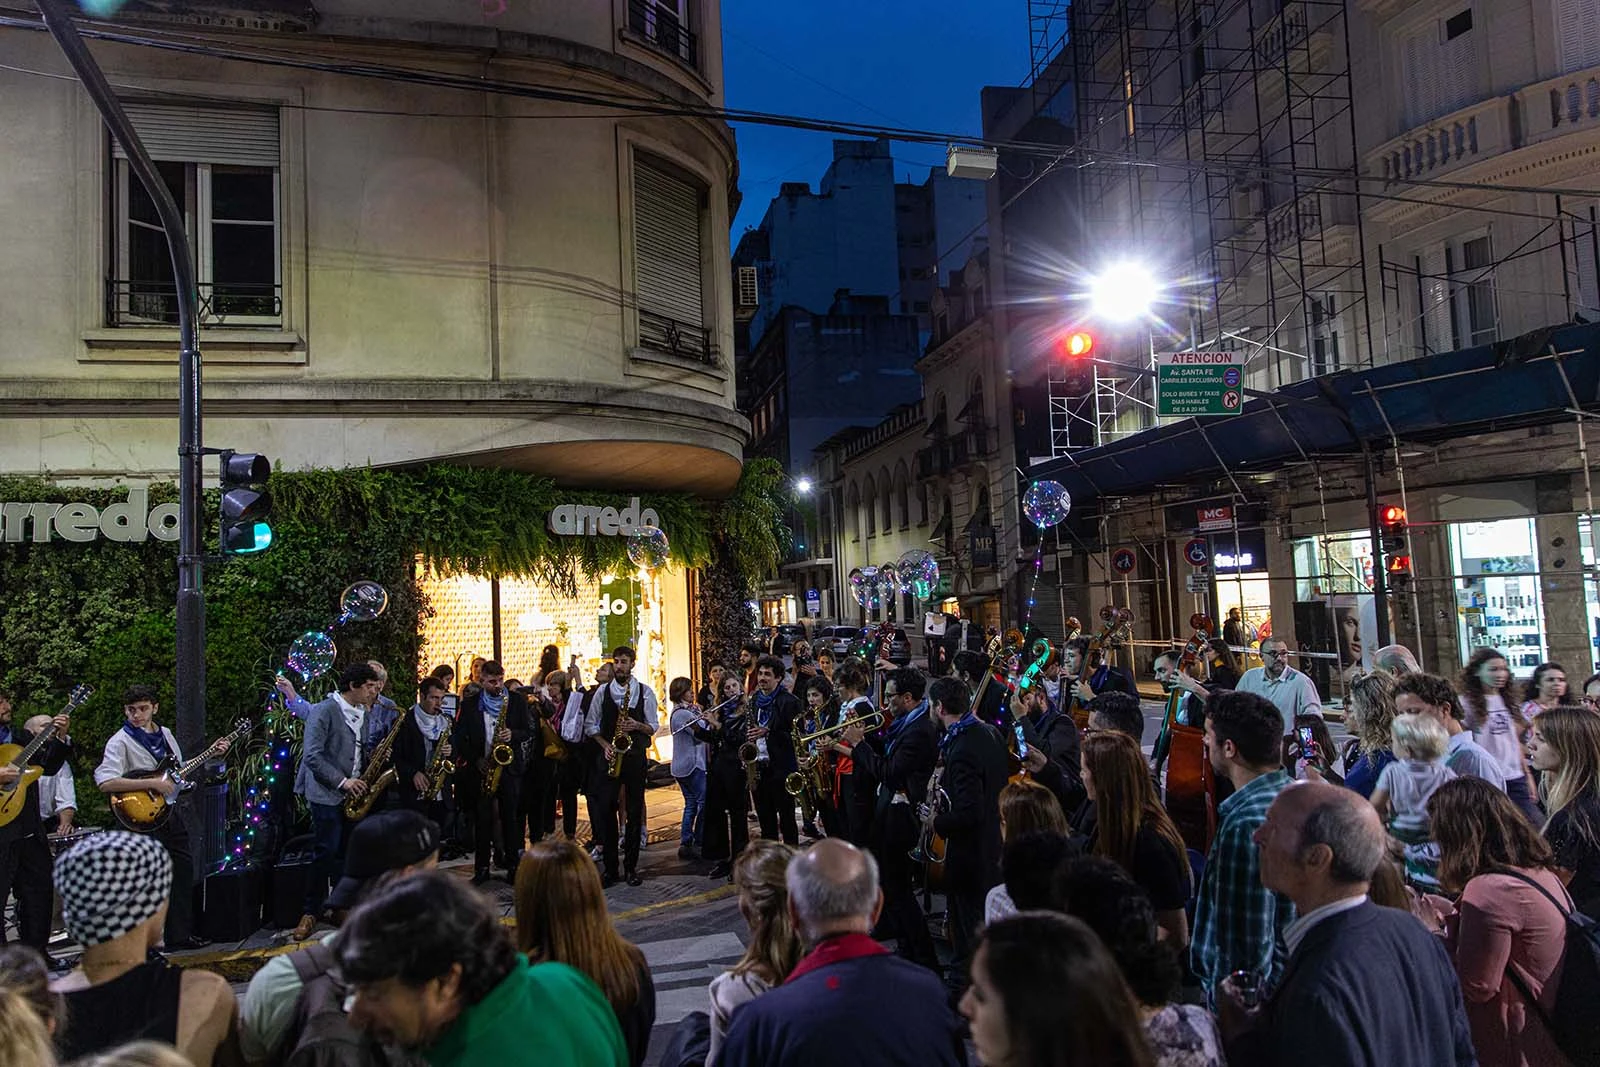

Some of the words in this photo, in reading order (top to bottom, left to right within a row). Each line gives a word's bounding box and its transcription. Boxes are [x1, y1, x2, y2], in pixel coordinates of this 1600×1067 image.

[1171, 353, 1232, 363] ATENCION
[0, 487, 180, 543] rredo
[549, 496, 660, 537] arredo
[1204, 508, 1225, 519] MC
